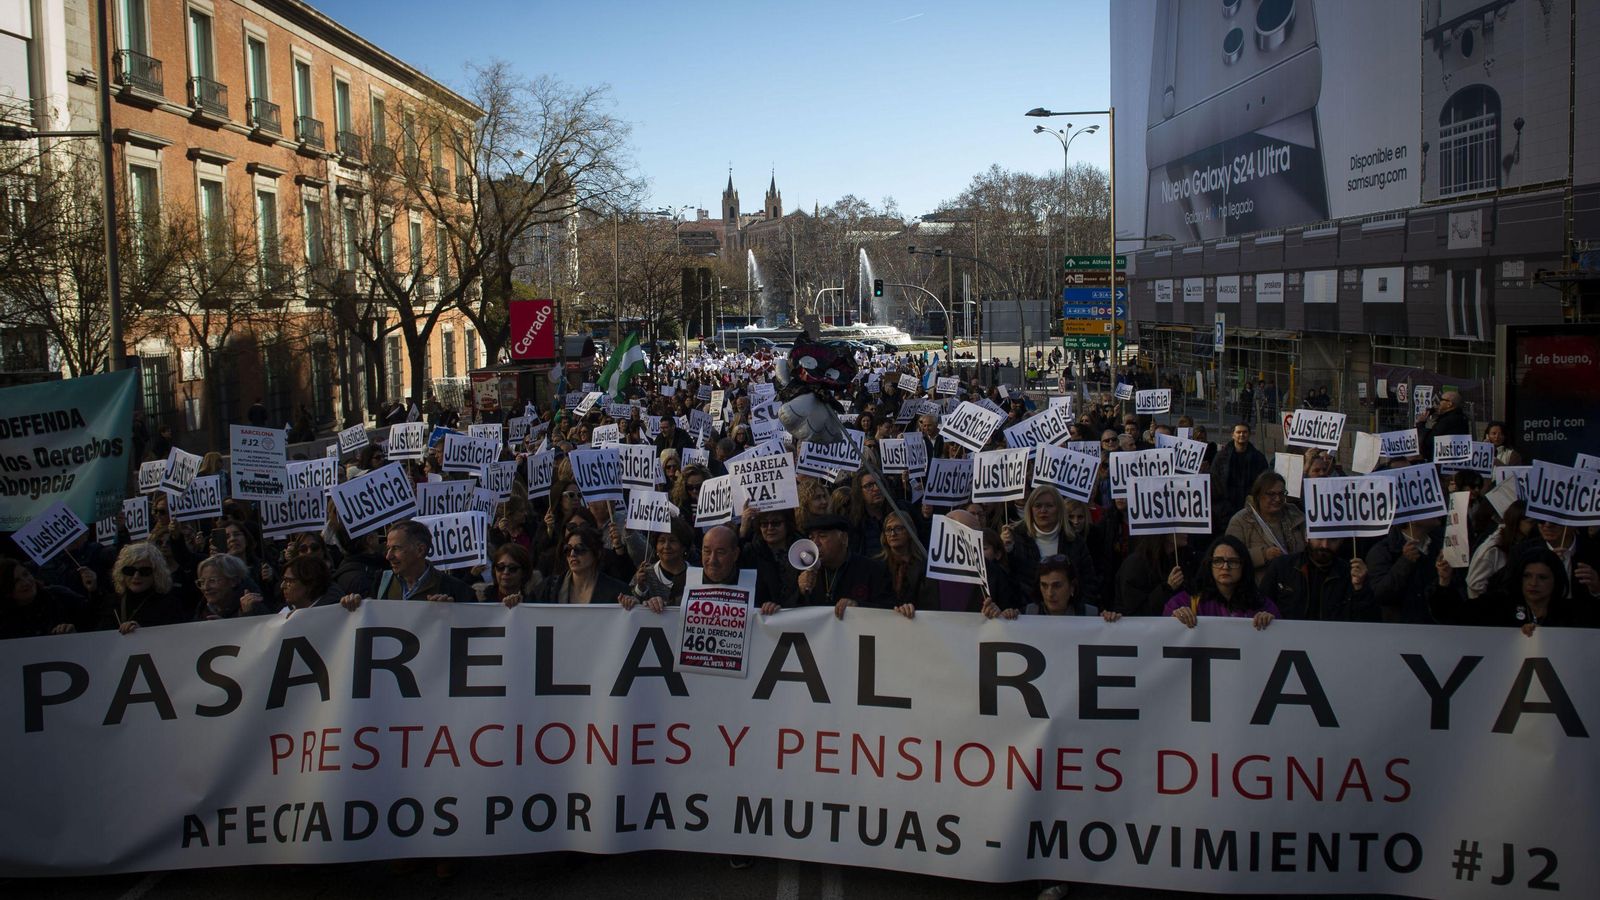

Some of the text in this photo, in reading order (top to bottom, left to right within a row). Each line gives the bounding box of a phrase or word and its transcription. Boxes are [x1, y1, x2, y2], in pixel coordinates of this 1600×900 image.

[1350, 145, 1407, 171] Disponible en
[1161, 144, 1290, 203] Nuevo Galaxy S24 Ultra
[1348, 167, 1407, 191] samsung.com
[515, 305, 552, 354] Cerrado
[1524, 353, 1592, 365] Ir de bueno,
[1137, 390, 1170, 408] Justicia!
[0, 408, 86, 439] DEFENDA
[241, 429, 273, 437] BARCELONA
[947, 404, 998, 443] Justicia!
[1009, 409, 1065, 448] Justicia!
[1291, 413, 1344, 440] Justicia!
[1523, 417, 1585, 431] pero ir con
[1523, 430, 1568, 442] el malo.
[341, 426, 365, 448] Justicia!
[390, 425, 424, 451] Justicia!
[33, 437, 123, 468] Derechos
[445, 438, 498, 463] Justicia!
[734, 457, 788, 475] PASARELA
[740, 470, 784, 485] AL RETA
[975, 452, 1028, 489] Justicia!
[1036, 448, 1098, 490] Justicia!
[339, 467, 413, 525] Justicia!
[747, 482, 776, 502] YA!
[1130, 480, 1209, 519] Justicia!
[1308, 482, 1393, 522] Justicia!
[262, 491, 325, 525] Justicia!
[20, 507, 79, 557] ¡Justicia!
[687, 615, 745, 628] COTIZACIÓN
[689, 601, 745, 618] 40 AÑOS
[684, 635, 716, 652] 460
[697, 627, 705, 635] DA
[708, 628, 737, 638] DERECHO
[23, 626, 1590, 738] PASARELA AL RETA YA
[269, 722, 1411, 802] PRESTACIONES Y PENSIONES DIGNAS
[181, 797, 459, 848] AFECTADOS
[486, 793, 591, 835] POR
[615, 792, 709, 833] LAS
[734, 796, 961, 856] MUTUAS
[1027, 820, 1423, 873] MOVIMIENTO
[1452, 839, 1560, 891] #J2
